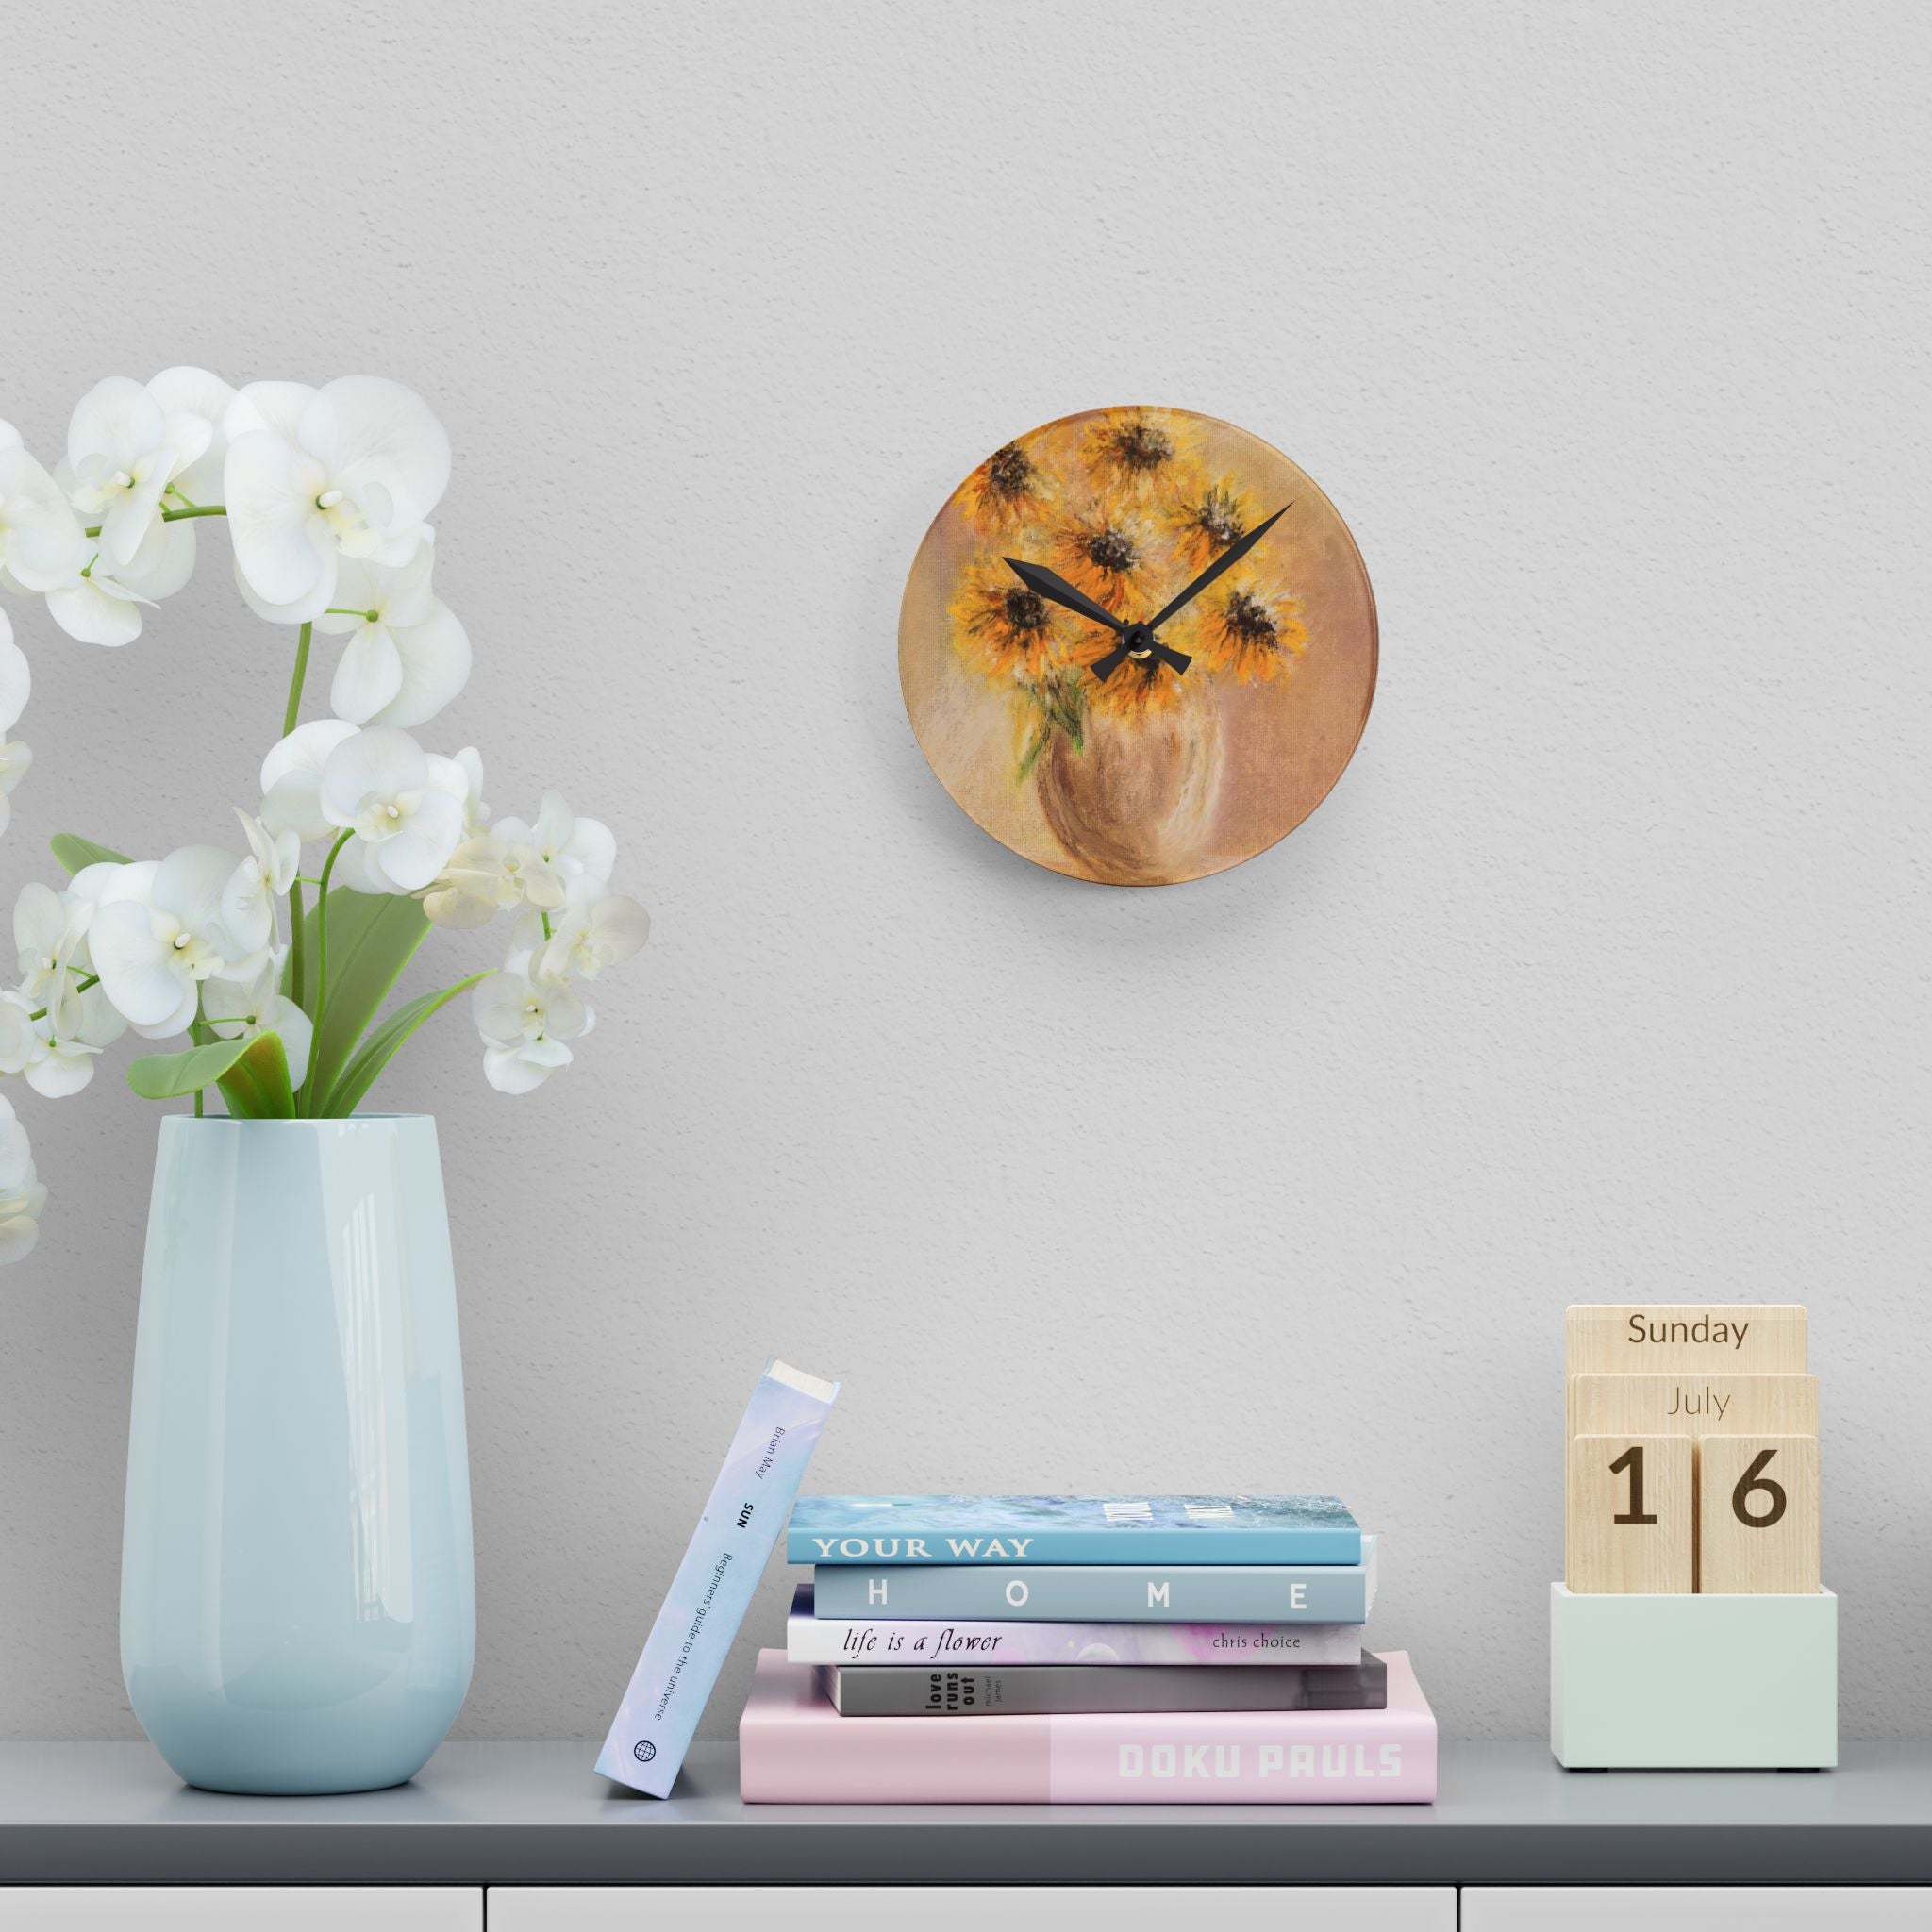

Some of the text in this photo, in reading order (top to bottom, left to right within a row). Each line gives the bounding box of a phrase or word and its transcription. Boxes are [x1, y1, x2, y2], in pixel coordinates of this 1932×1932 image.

[1627, 1313, 1750, 1350] Sunday
[1667, 1386, 1731, 1421] July
[755, 1426, 786, 1480] Brian May
[736, 1502, 754, 1529] SUN
[811, 1538, 1035, 1557] YOUR WAY
[688, 1607, 707, 1640] guide
[682, 1641, 693, 1654] to
[843, 1628, 1003, 1659] life is a flower
[1212, 1632, 1301, 1649] chris choice
[674, 1655, 688, 1674] the
[654, 1675, 678, 1722] universe
[925, 1674, 942, 1709] love
[946, 1673, 958, 1711] runs
[960, 1676, 975, 1706] out
[1118, 1744, 1403, 1778] DOKU PAULS
